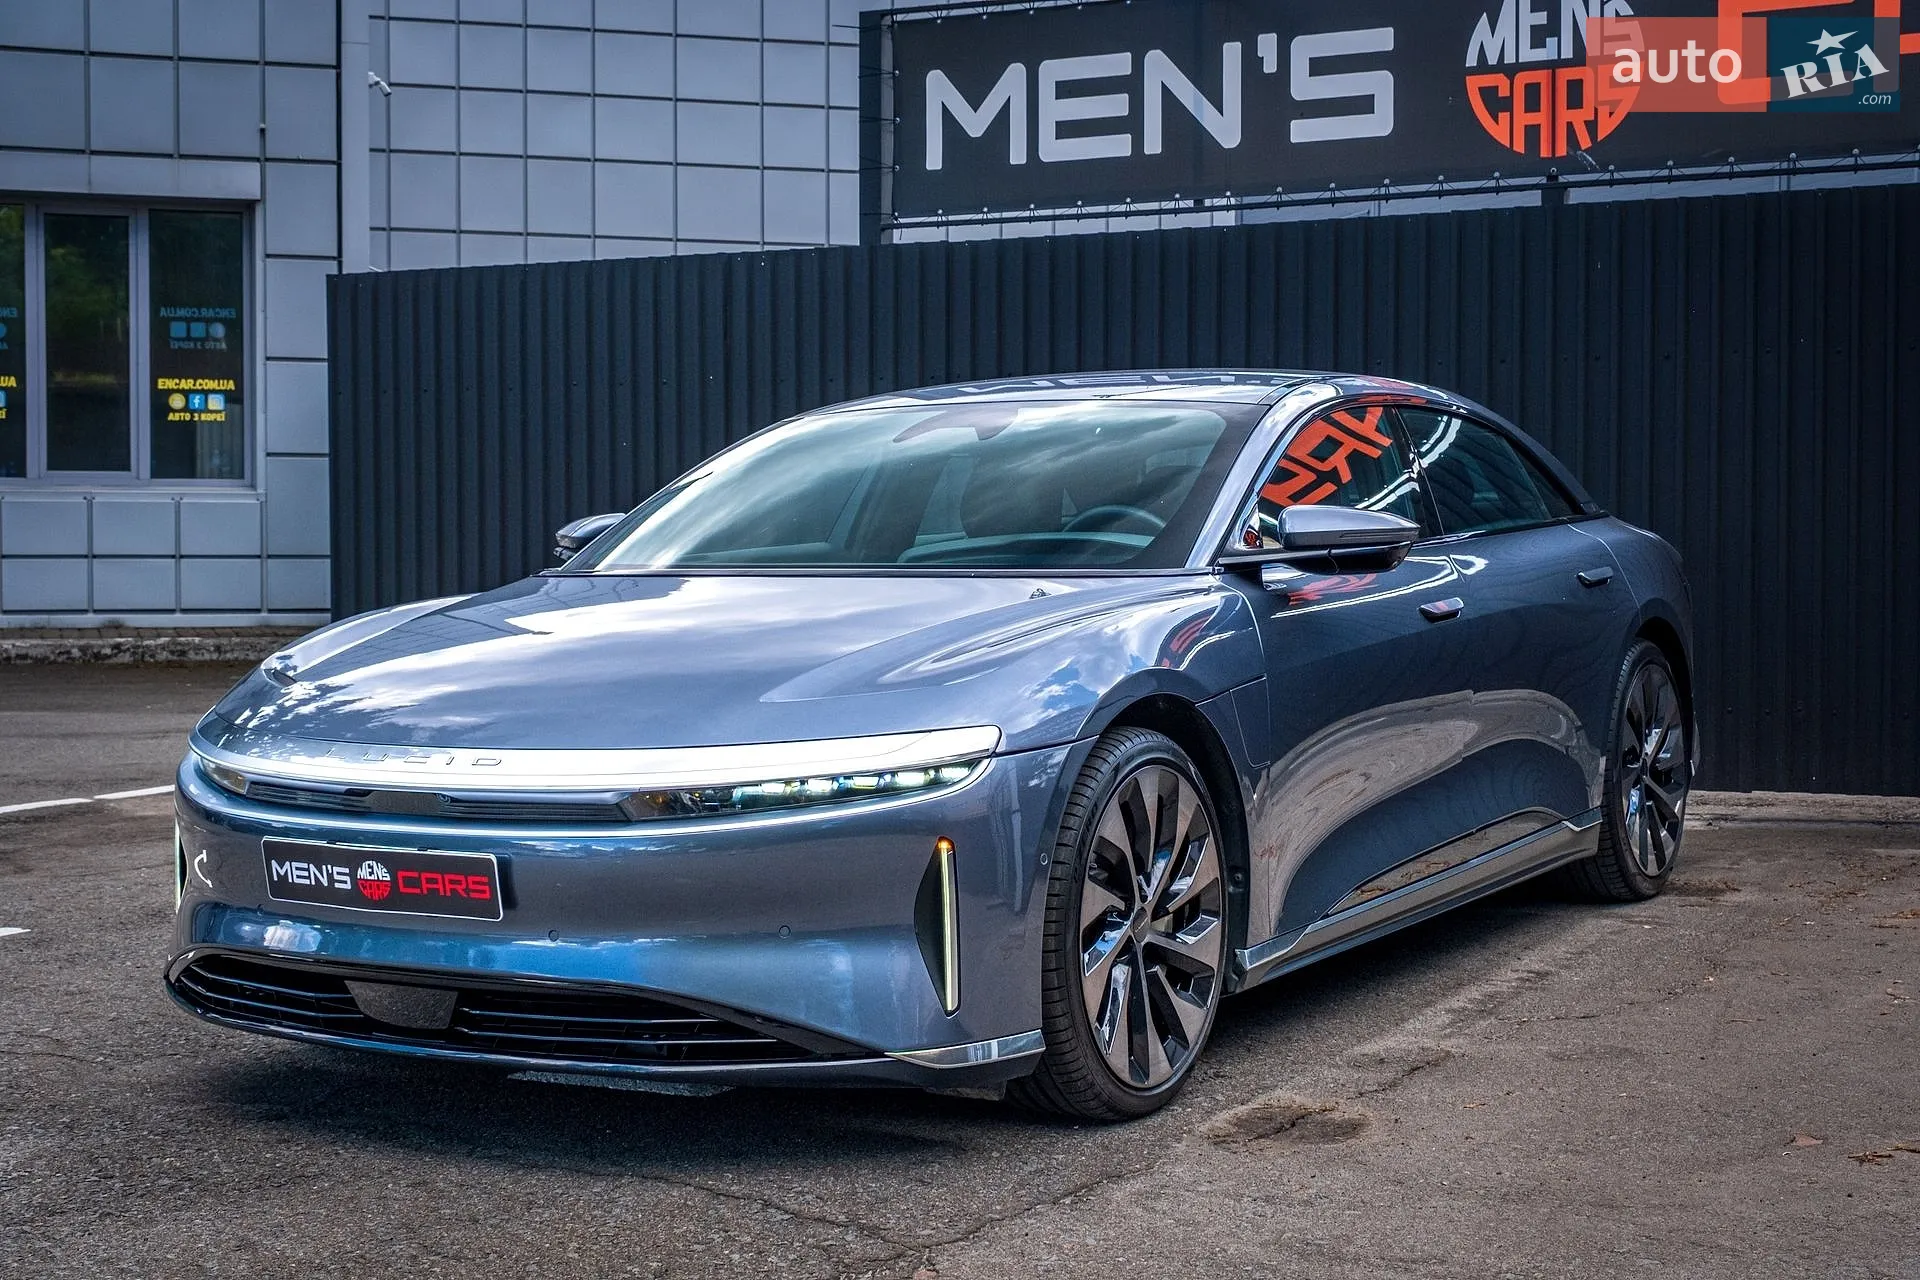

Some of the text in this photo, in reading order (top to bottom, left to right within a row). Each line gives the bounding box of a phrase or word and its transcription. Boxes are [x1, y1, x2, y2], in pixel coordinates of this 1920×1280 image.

[926, 27, 1394, 170] MEN'S
[1465, 61, 1645, 158] CARS
[157, 378, 235, 391] ENCAR.COM.UA
[326, 748, 502, 766] LUCID
[271, 859, 491, 900] MEN'S CARS
